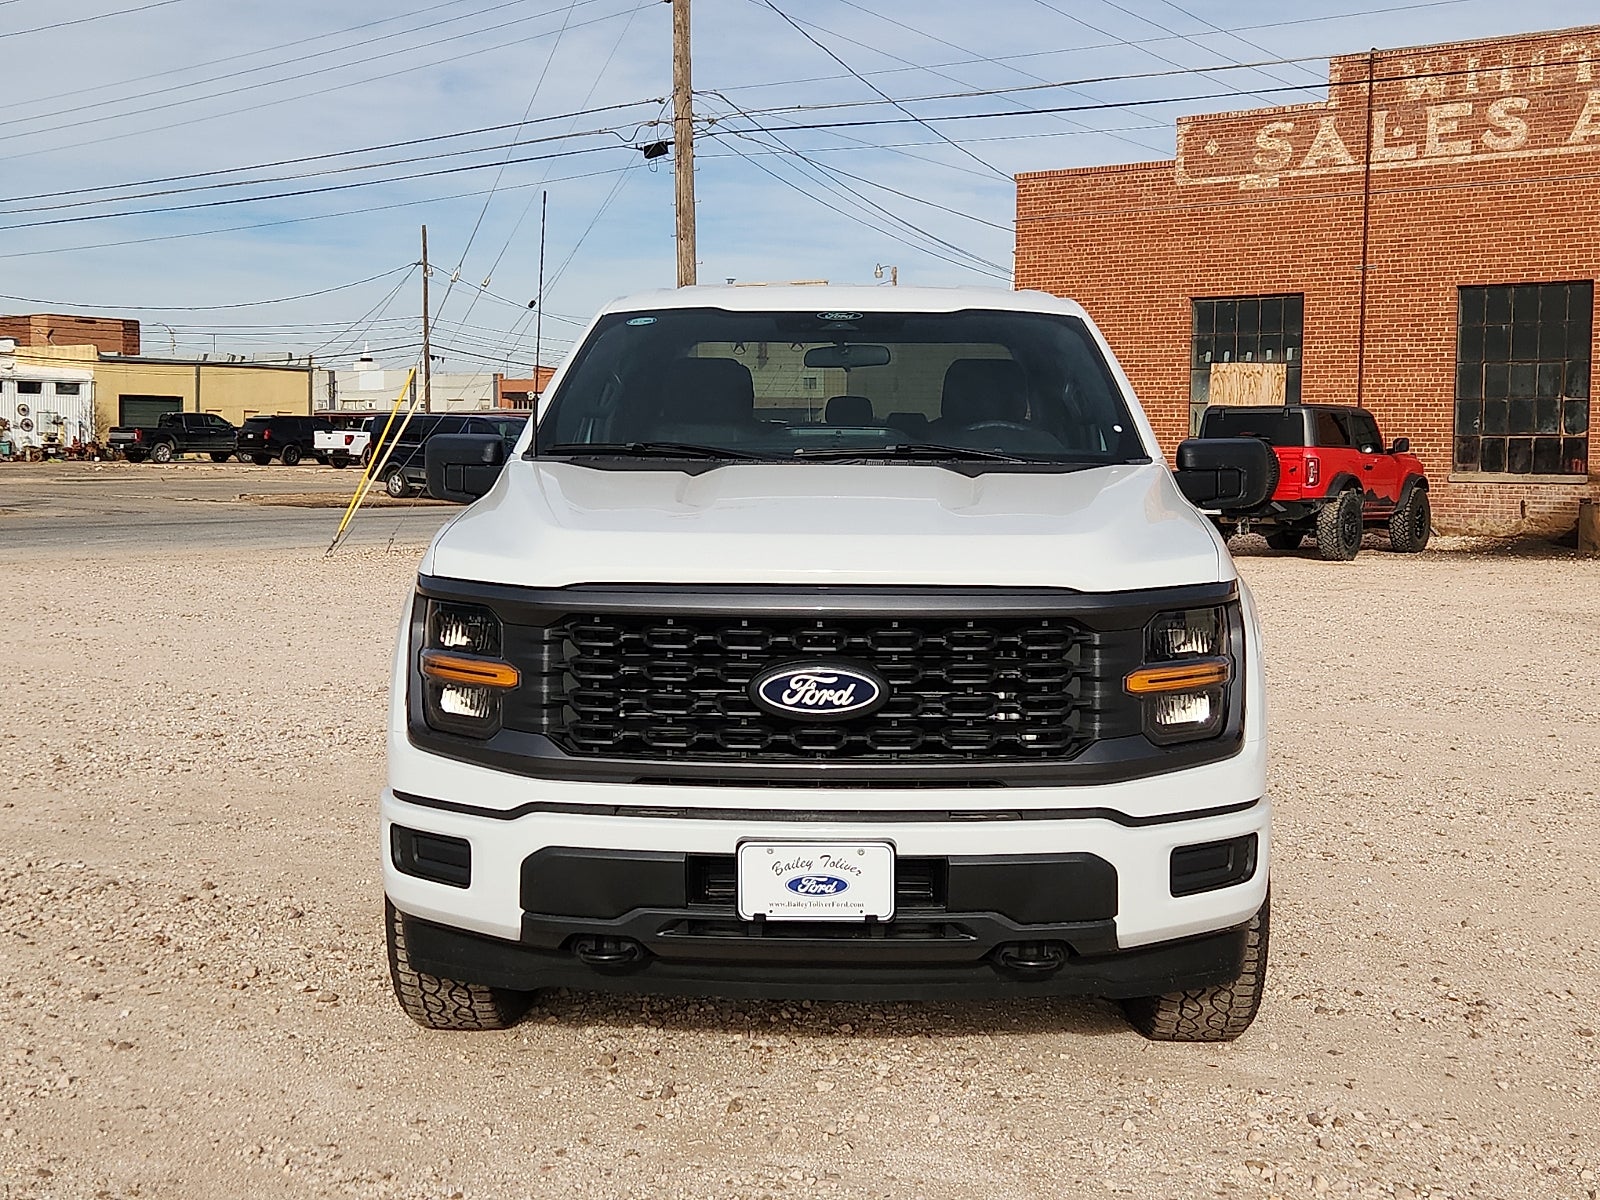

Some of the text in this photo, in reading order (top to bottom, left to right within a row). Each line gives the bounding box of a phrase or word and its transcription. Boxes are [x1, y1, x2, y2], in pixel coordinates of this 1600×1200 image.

[1253, 96, 1531, 171] SALES
[824, 312, 855, 320] Ford
[781, 674, 857, 706] Ford
[772, 854, 862, 877] Bailey Toliver
[797, 876, 838, 894] Ford
[768, 901, 865, 910] www.BaileyToliverFord.com
